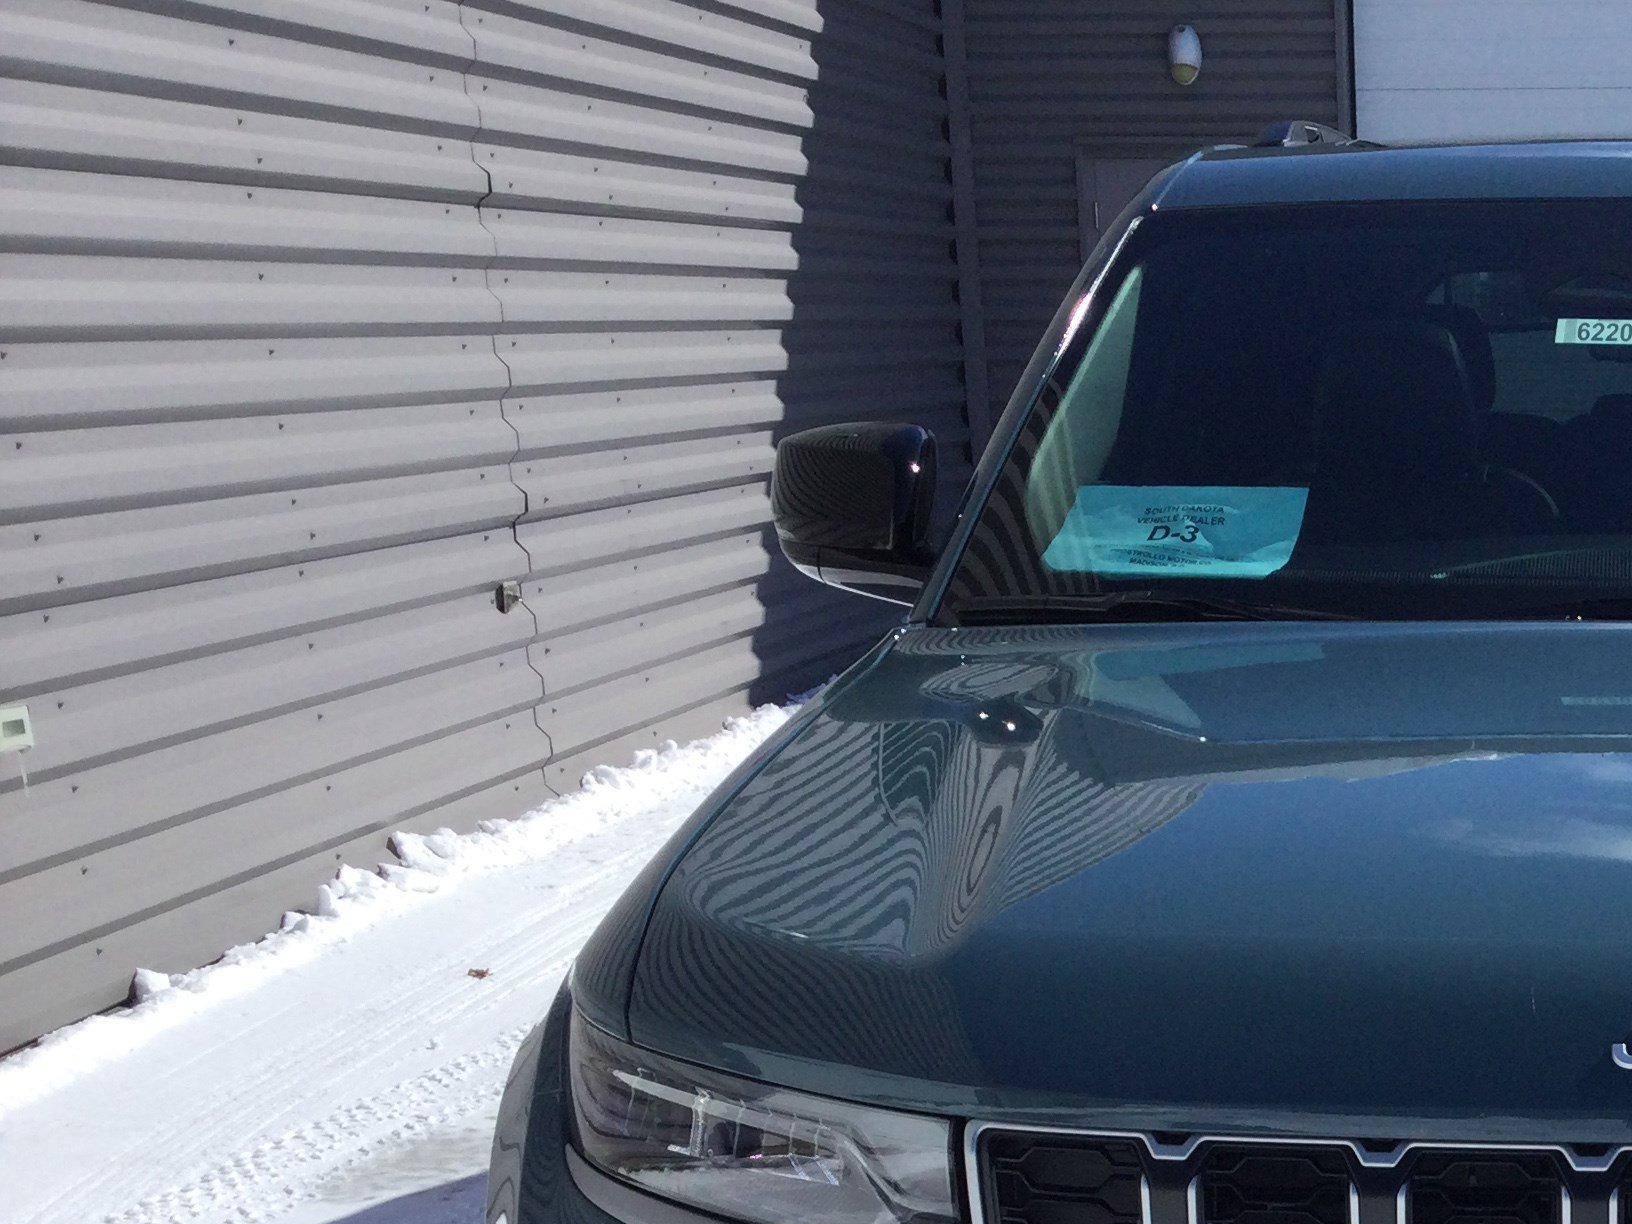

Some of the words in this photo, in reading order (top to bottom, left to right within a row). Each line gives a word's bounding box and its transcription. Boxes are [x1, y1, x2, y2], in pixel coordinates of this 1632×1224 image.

[1577, 322, 1632, 342] 6220
[1145, 506, 1180, 515] SOUTH
[1181, 505, 1224, 514] DAKOTA
[1137, 514, 1180, 525] VEHICLE
[1182, 514, 1226, 526] DEALER
[1146, 525, 1199, 542] D-3
